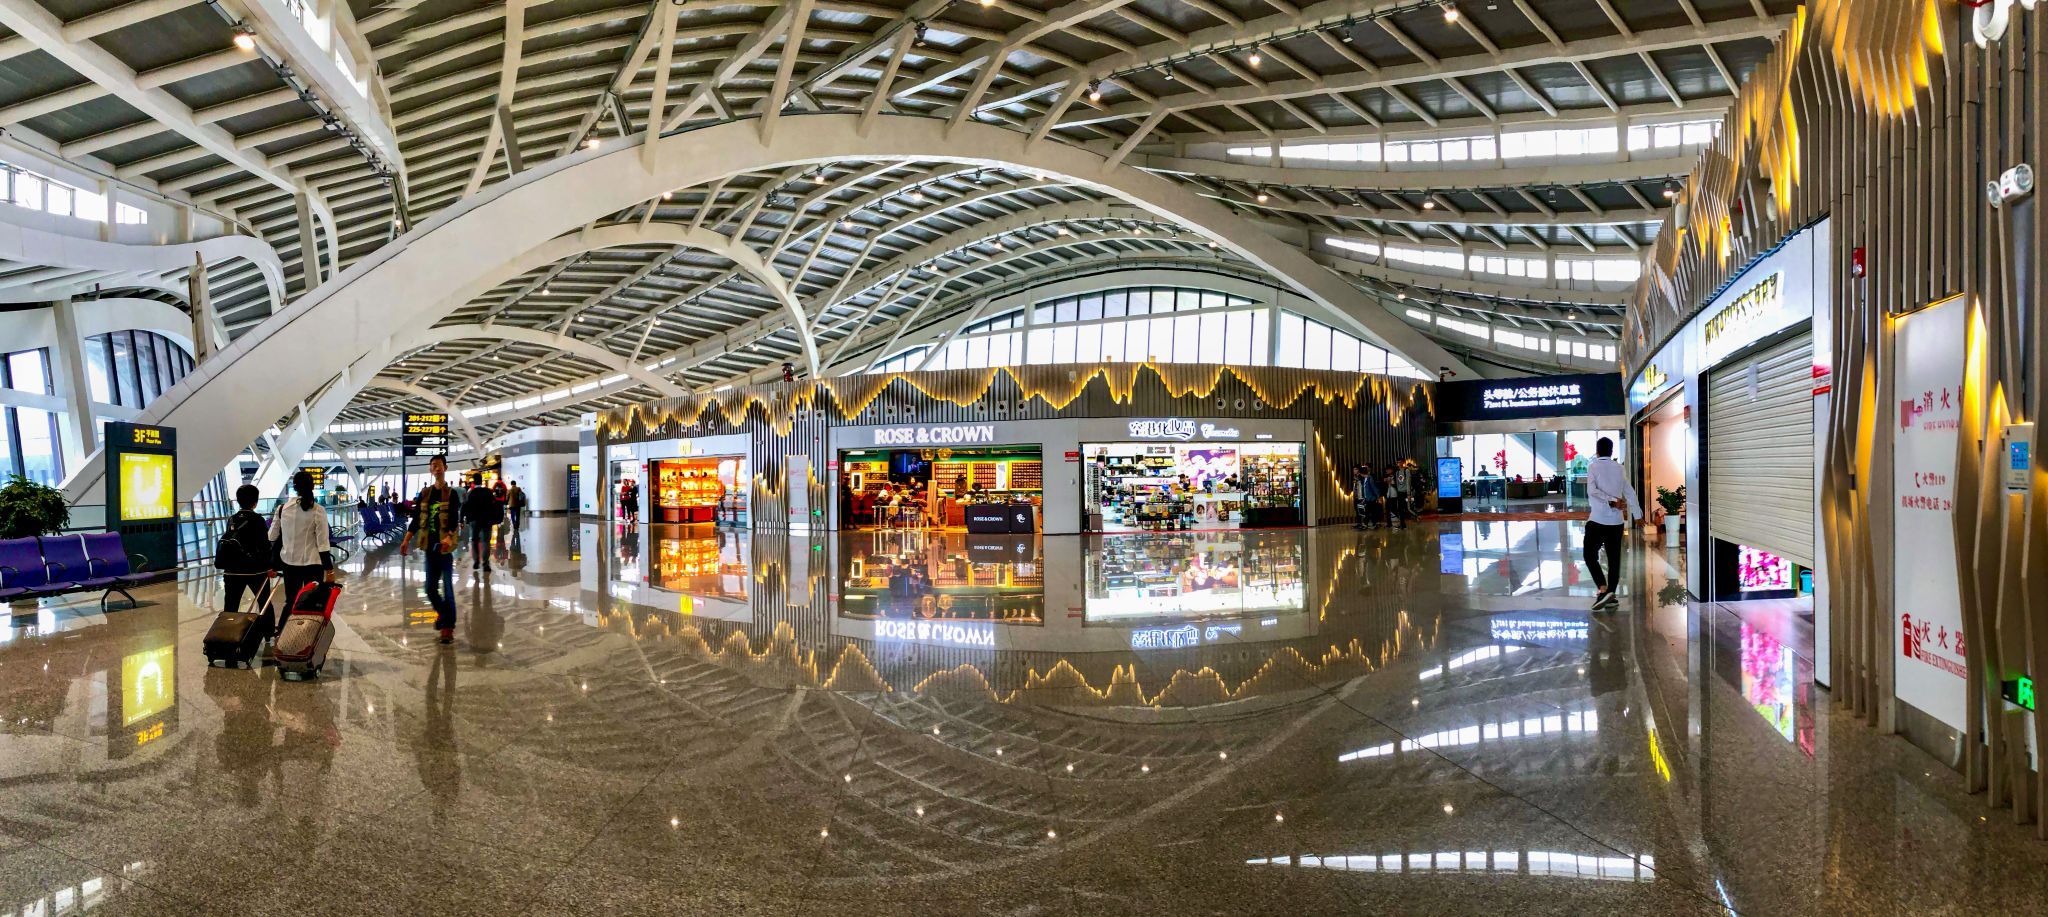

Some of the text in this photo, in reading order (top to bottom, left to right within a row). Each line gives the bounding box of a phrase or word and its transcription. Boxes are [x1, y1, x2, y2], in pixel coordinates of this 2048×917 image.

[1509, 399, 1538, 407] business
[1539, 397, 1556, 406] class
[1556, 397, 1580, 406] lounge
[134, 428, 145, 443] 3F
[874, 425, 994, 444] ROSE & CROWN
